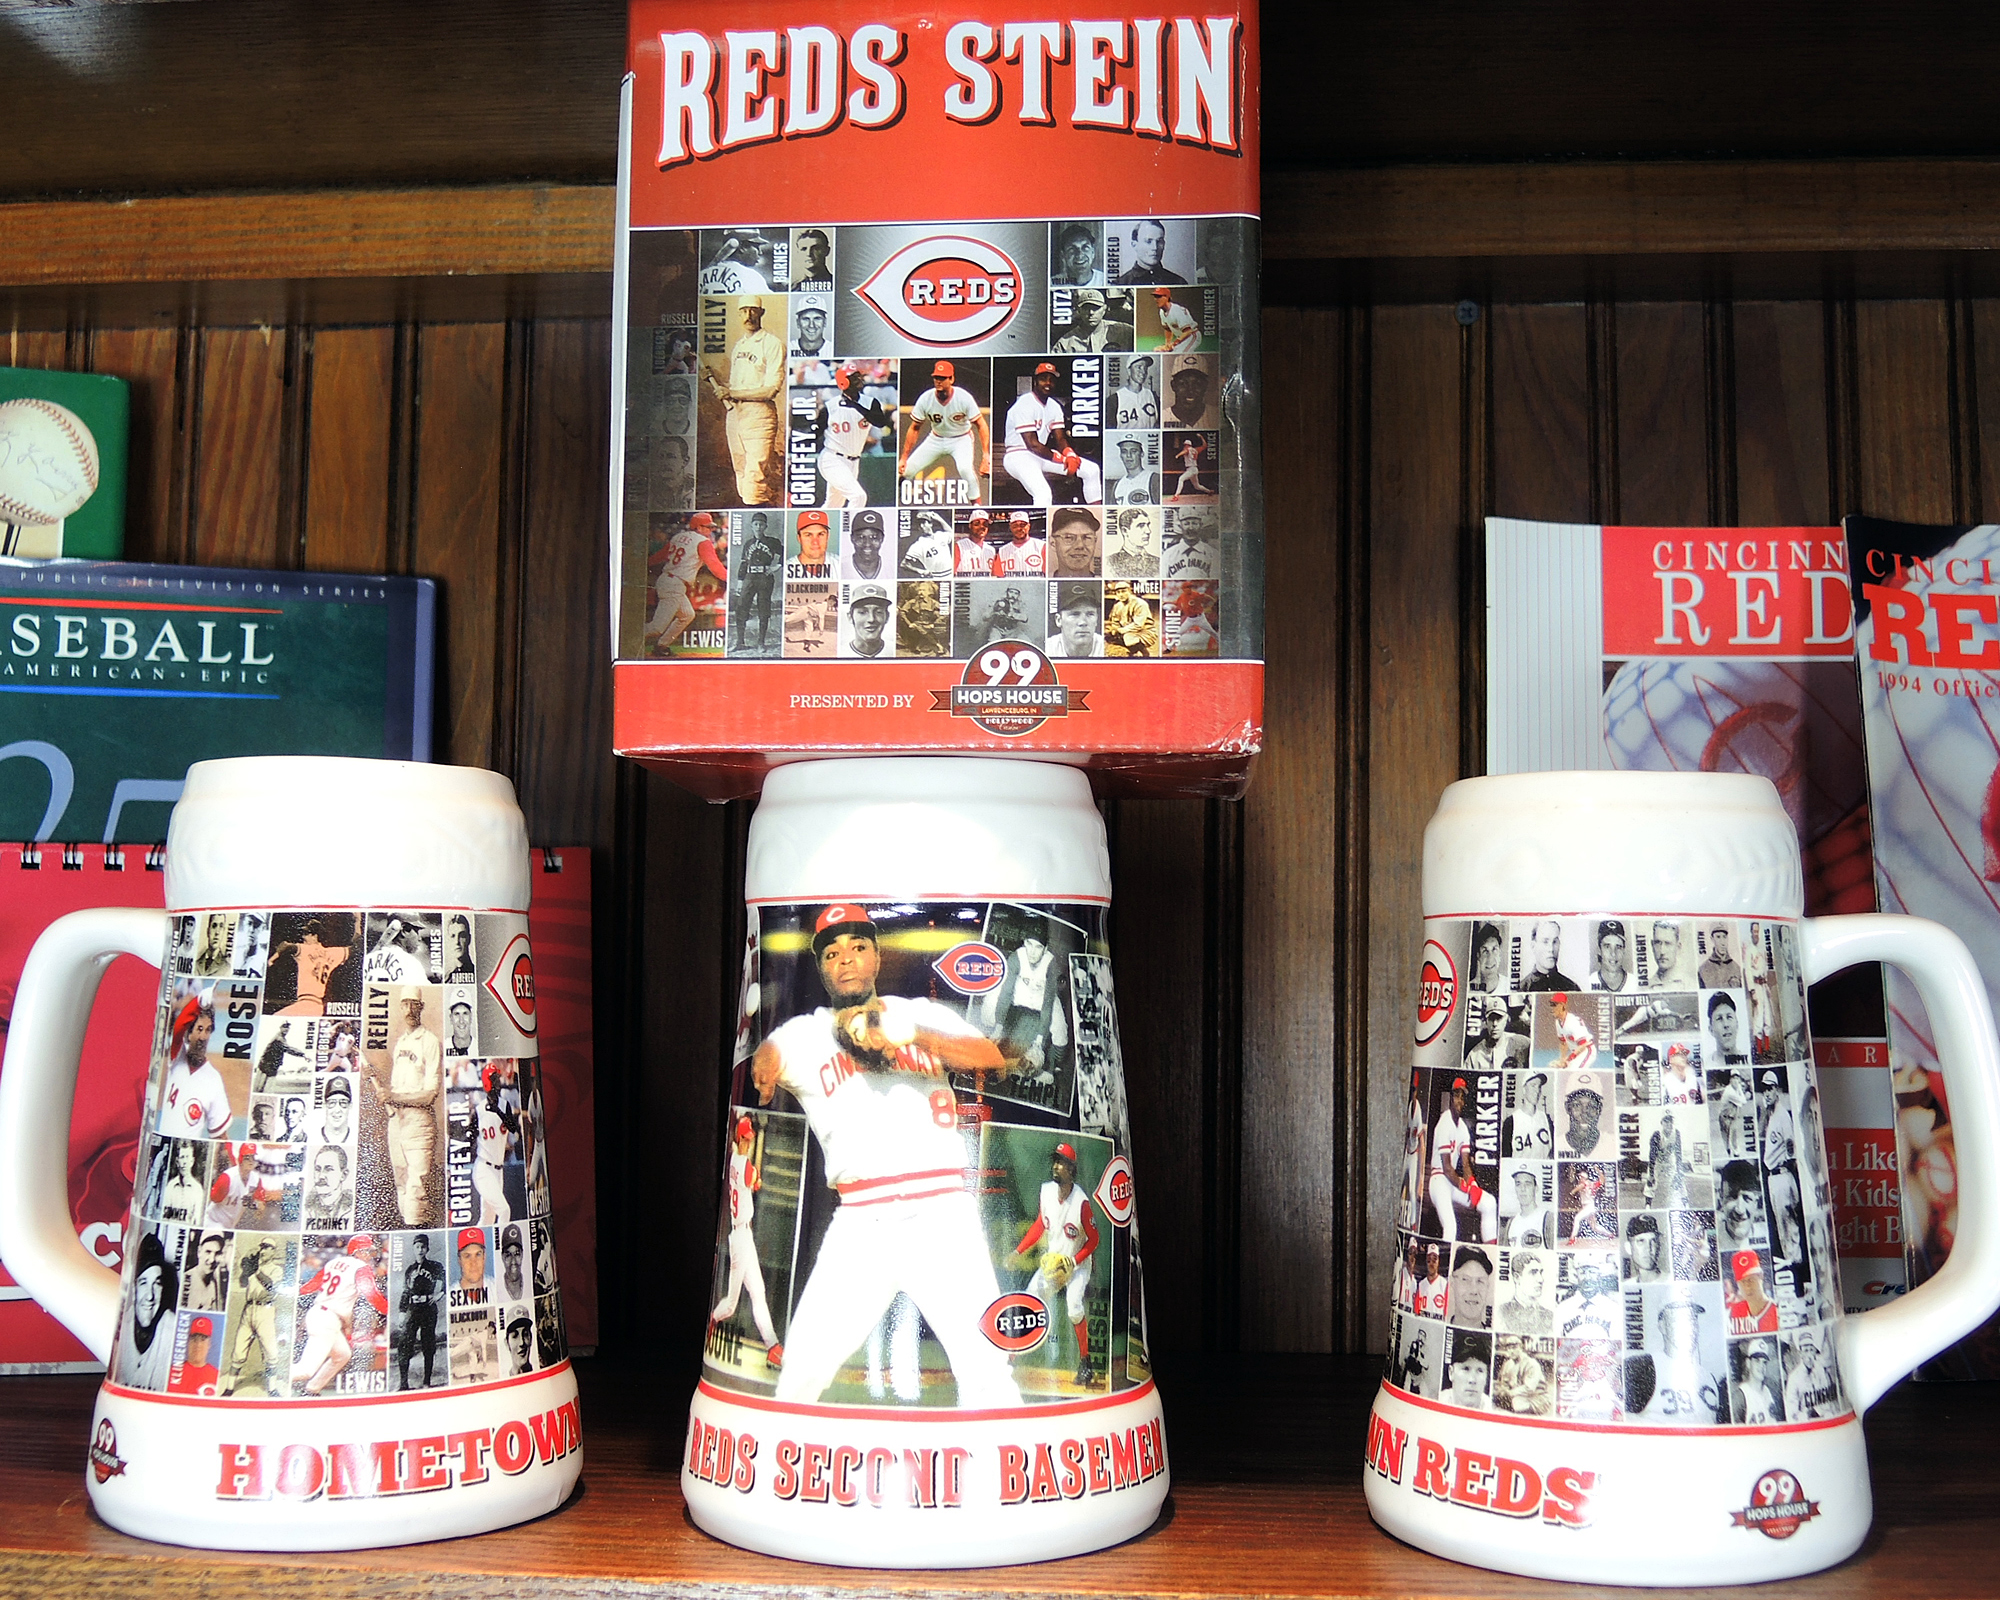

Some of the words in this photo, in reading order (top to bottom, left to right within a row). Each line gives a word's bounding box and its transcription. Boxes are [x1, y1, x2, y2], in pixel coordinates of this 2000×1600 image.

[657, 24, 904, 168] REDS
[944, 17, 1240, 155] STEIN
[772, 242, 788, 283] BARNES
[1107, 236, 1120, 284] ELBERFELD
[800, 281, 832, 292] HABERER
[909, 277, 1015, 306] REDS
[661, 313, 696, 325] RUSSELL
[1053, 288, 1072, 325] LUTZ
[1203, 288, 1216, 336] BENZINGER
[704, 298, 727, 354] REILLY
[1108, 356, 1120, 388] OSTEEN
[792, 389, 817, 420] JR.
[1071, 357, 1100, 438] PARKER
[831, 421, 850, 435] 30
[1119, 408, 1139, 424] 34
[1147, 433, 1159, 466] NEVILLE
[1207, 431, 1217, 461] SERVICE
[790, 424, 820, 507] GRIFFEY,
[900, 479, 969, 506] OESTER
[732, 512, 742, 546] SUTTHOFF
[899, 509, 911, 538] WELSH
[1106, 508, 1118, 535] DOLAN
[1163, 508, 1174, 533] EWING
[924, 546, 939, 559] 45
[20, 572, 108, 586] PUBLIC
[131, 575, 281, 594] TELEVISION
[302, 585, 387, 599] SERIES
[786, 563, 831, 579] SEXTON
[786, 583, 829, 594] BLACKBURN
[938, 581, 950, 616] BALDWIN
[1133, 582, 1160, 594] MAGEE
[1653, 570, 1856, 645] RED
[0, 614, 275, 665] SEBALL
[683, 630, 724, 649] LEWIS
[1165, 606, 1182, 647] STONE
[3, 661, 167, 681] AMERICAN
[201, 669, 270, 684] EPIC
[979, 649, 1042, 687] 99
[1876, 671, 1922, 695] 1994
[789, 694, 889, 708] PRESENTED
[892, 694, 914, 708] BY
[956, 690, 1003, 705] HOPS
[1005, 689, 1063, 705] HOUSE
[985, 717, 1034, 725] HOLLYWOOD
[225, 921, 236, 958] STENZEL
[430, 929, 442, 974] BARNES
[1697, 931, 1707, 955] SMITH
[1763, 928, 1775, 970] HUGGINS
[165, 930, 179, 1003] BUSHELMAN
[958, 962, 1004, 976] REDS
[1510, 936, 1522, 991] ELBERFELD
[1635, 933, 1649, 987] GASTRIGHT
[223, 983, 259, 1059] ROSE
[326, 1002, 360, 1016] RUSSELL
[366, 986, 389, 1050] REILLY
[1466, 995, 1483, 1037] LUTZ
[1597, 996, 1610, 1051] BENZINGER
[316, 1021, 332, 1072] LUEBBERS
[1694, 1043, 1702, 1058] BELL
[313, 1076, 325, 1110] TEKULVE
[1506, 1073, 1517, 1109] OSTEEN
[1648, 1060, 1660, 1106] BROSNAN
[450, 1093, 471, 1127] JR.
[929, 1089, 957, 1128] 8
[1475, 1075, 1500, 1166] PARKER
[481, 1126, 496, 1140] 30
[1514, 1136, 1533, 1151] 34
[1745, 1115, 1757, 1153] ALLEN
[450, 1131, 473, 1225] GRIFFEY,
[1541, 1164, 1553, 1202] NEVILLE
[1844, 1178, 1900, 1209] Kids
[305, 1217, 350, 1230] PECHINEY
[529, 1221, 538, 1251] WELSH
[392, 1235, 404, 1272] SUTTHOFF
[1499, 1250, 1510, 1282] DOLAN
[321, 1274, 344, 1295] 28
[449, 1286, 490, 1307] SEXTON
[1772, 1255, 1801, 1330] BRADY
[449, 1309, 488, 1325] BLACKBURN
[997, 1312, 1047, 1333] REDS
[1625, 1288, 1645, 1351] NUXHALL
[1727, 1316, 1760, 1335] NIXON
[170, 1312, 192, 1386] KLINGENBECK
[704, 1320, 745, 1367] OONE
[1444, 1328, 1454, 1365] WEHMEIER
[336, 1371, 385, 1394] LEWIS
[1660, 1387, 1694, 1416] 39
[96, 1423, 114, 1447] 99
[215, 1396, 581, 1501] HOMETOWN
[688, 1415, 758, 1494] REDS
[998, 1417, 1165, 1505] BASEMEN
[1413, 1437, 1601, 1530] REDS
[1758, 1475, 1794, 1505] 99
[1746, 1506, 1775, 1522] HOPS
[1776, 1501, 1809, 1519] HOUSE
